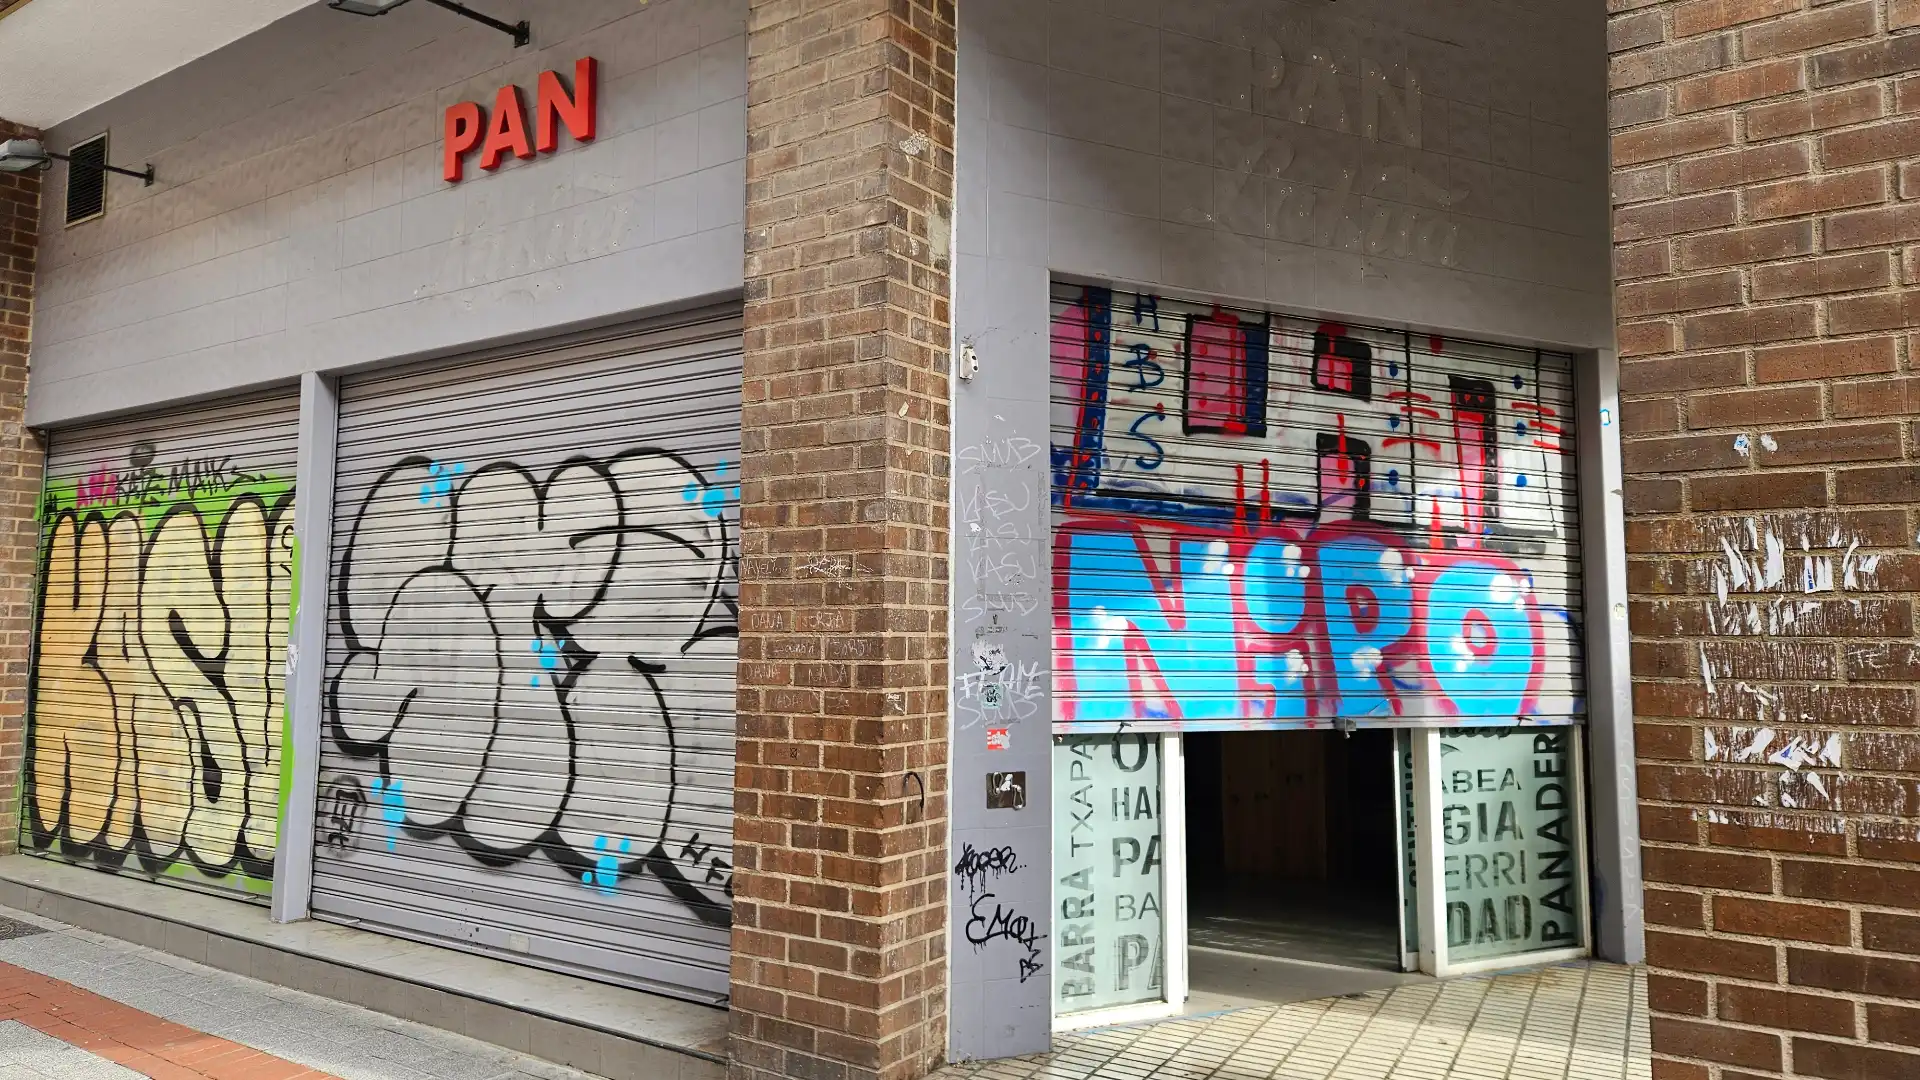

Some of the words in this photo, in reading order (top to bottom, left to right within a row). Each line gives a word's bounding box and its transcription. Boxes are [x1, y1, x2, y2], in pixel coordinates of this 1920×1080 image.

[443, 56, 598, 183] PAN
[1441, 767, 1522, 794] BEA
[1111, 785, 1161, 822] HA
[1443, 800, 1524, 845] GIA
[1444, 850, 1526, 892] ERRI
[1114, 891, 1160, 922] BA
[1060, 866, 1095, 999] BARRA
